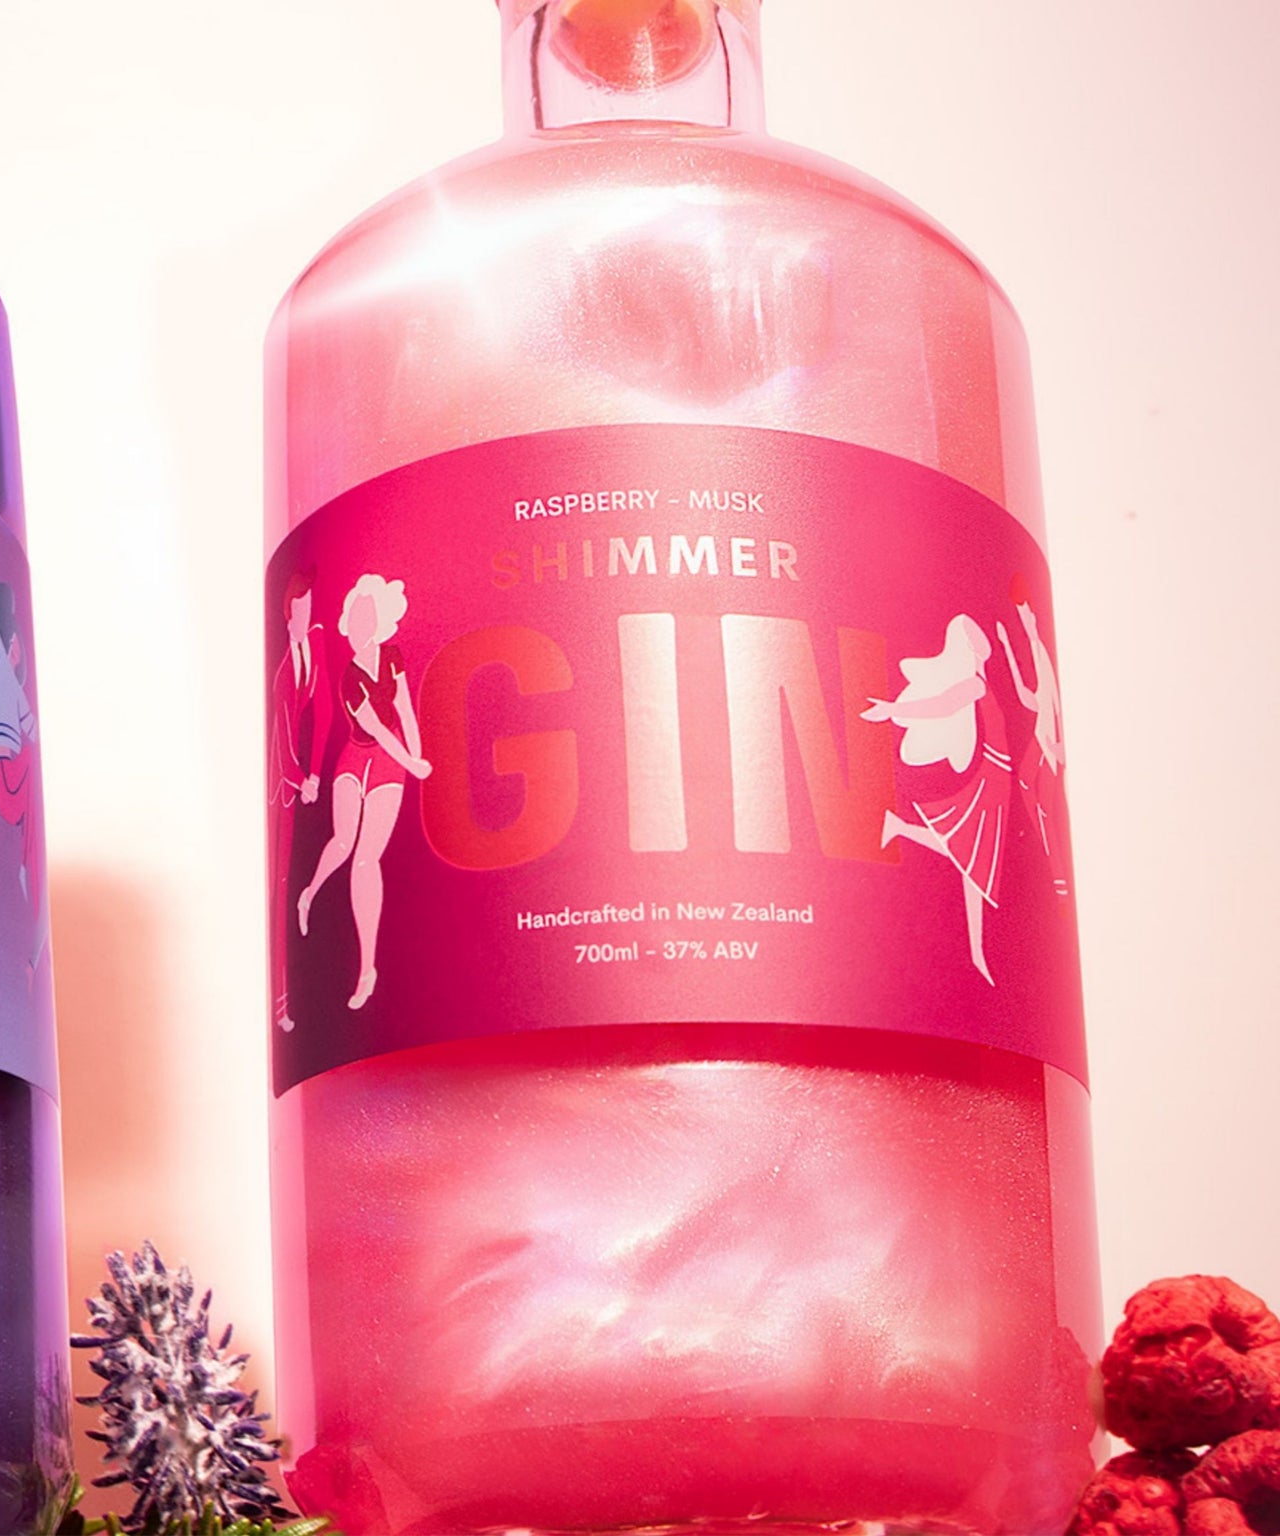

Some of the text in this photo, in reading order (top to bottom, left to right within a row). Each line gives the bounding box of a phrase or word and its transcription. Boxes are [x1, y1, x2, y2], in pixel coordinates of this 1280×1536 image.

[514, 490, 660, 521] RASPBERRY
[689, 490, 764, 514] MUSK
[491, 535, 800, 589] SHIMMER
[418, 612, 903, 871] GIN
[517, 902, 813, 930] Handcrafted in New Zealand
[575, 942, 638, 965] 700ml
[663, 940, 707, 960] 37%
[713, 941, 758, 960] ABV
